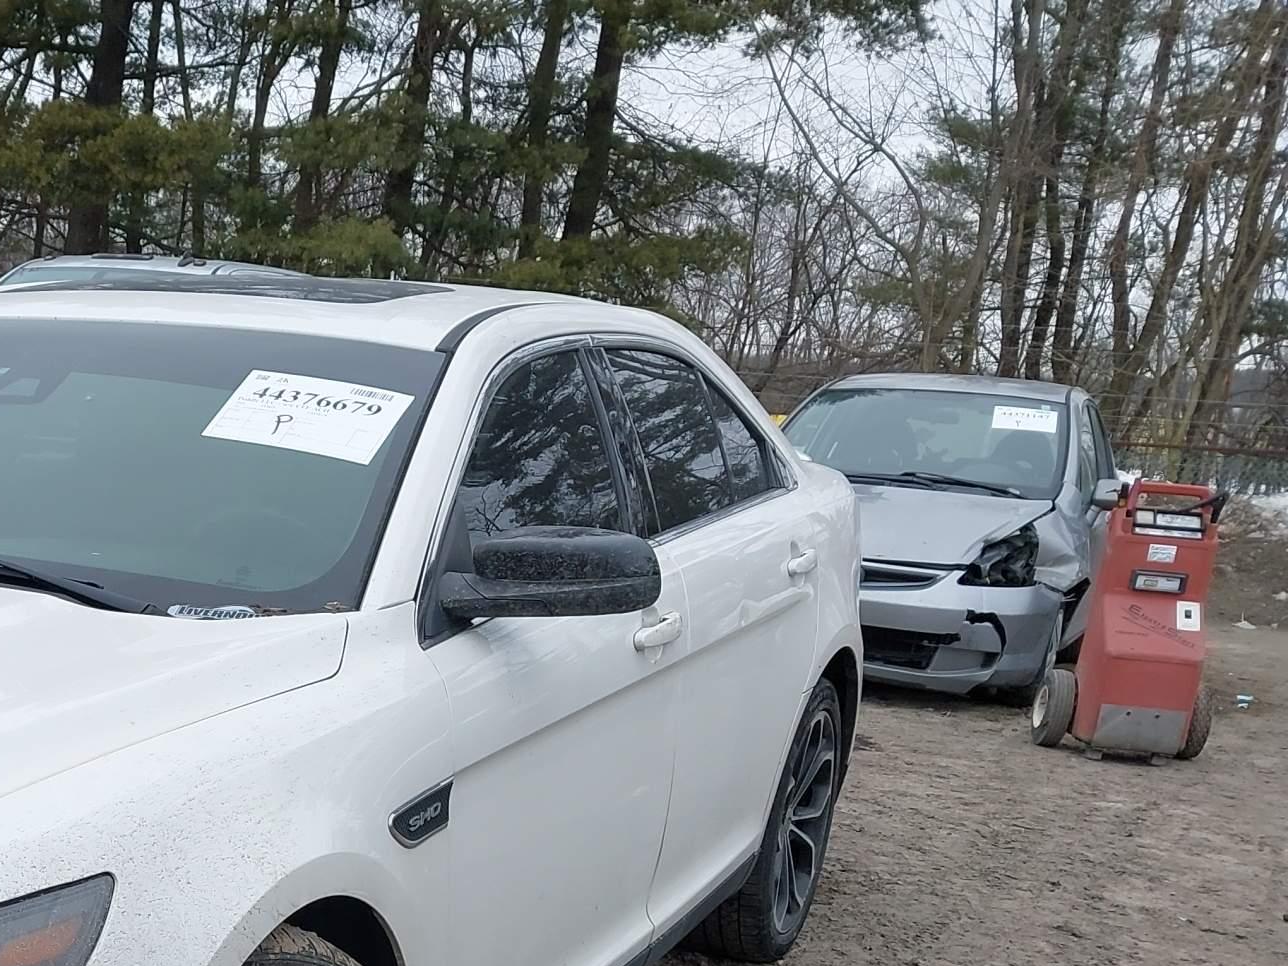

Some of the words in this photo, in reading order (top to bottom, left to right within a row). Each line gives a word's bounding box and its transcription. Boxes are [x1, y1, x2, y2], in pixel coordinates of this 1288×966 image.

[252, 386, 383, 417] 44376679
[271, 414, 294, 436] P
[408, 802, 441, 831] SHO
